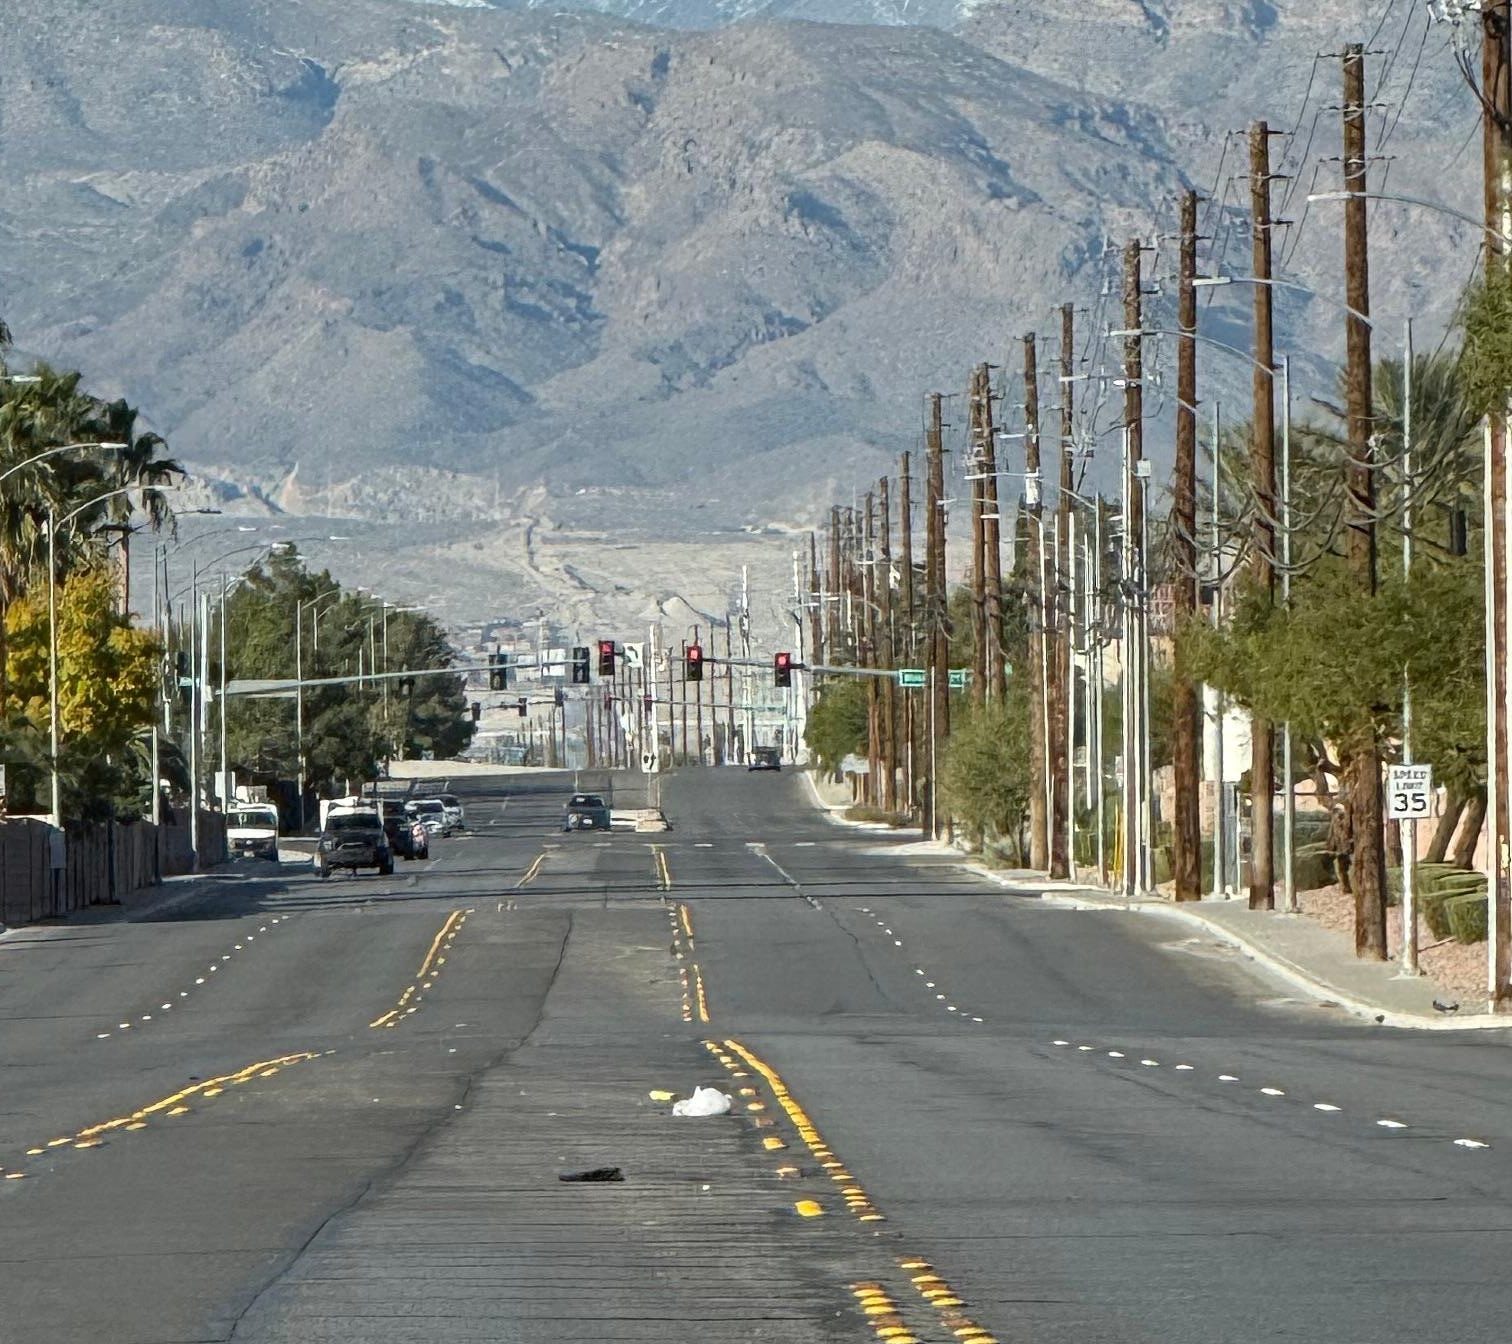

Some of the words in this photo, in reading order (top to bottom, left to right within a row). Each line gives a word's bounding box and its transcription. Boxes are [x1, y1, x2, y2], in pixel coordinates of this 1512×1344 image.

[1394, 770, 1426, 779] SPEED
[1396, 782, 1423, 790] LIMIT
[1394, 793, 1426, 811] 35
